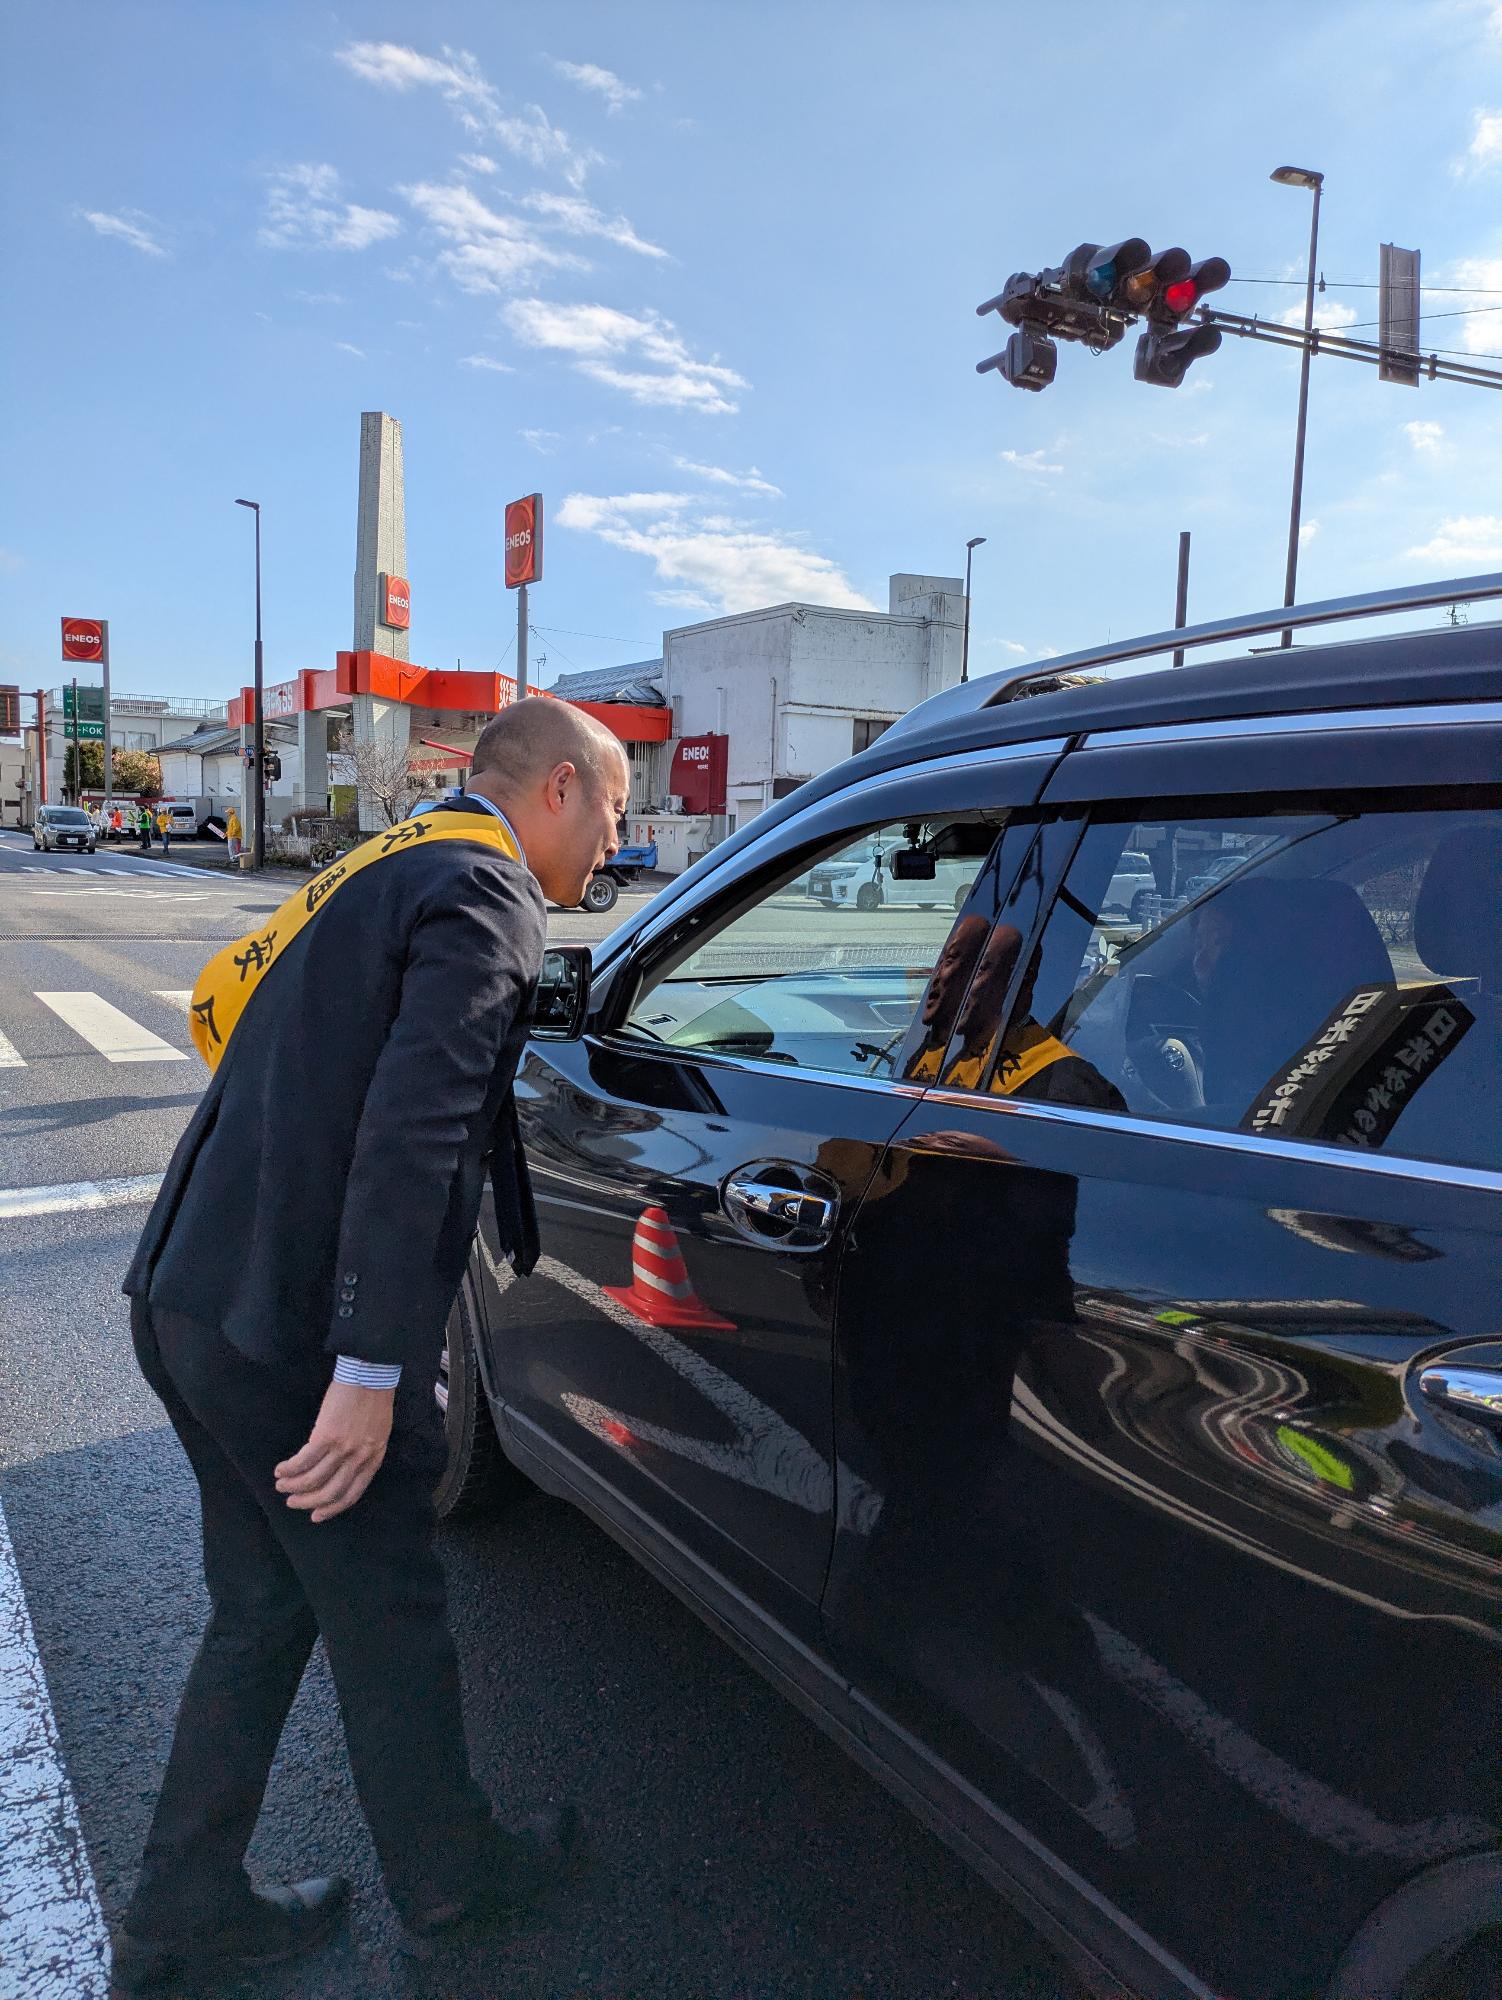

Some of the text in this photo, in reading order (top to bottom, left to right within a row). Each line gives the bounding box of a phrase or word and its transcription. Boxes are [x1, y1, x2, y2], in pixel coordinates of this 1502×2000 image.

[506, 529, 531, 551] ENEOS
[389, 594, 409, 609] ENEOS
[65, 634, 100, 644] ENEOS
